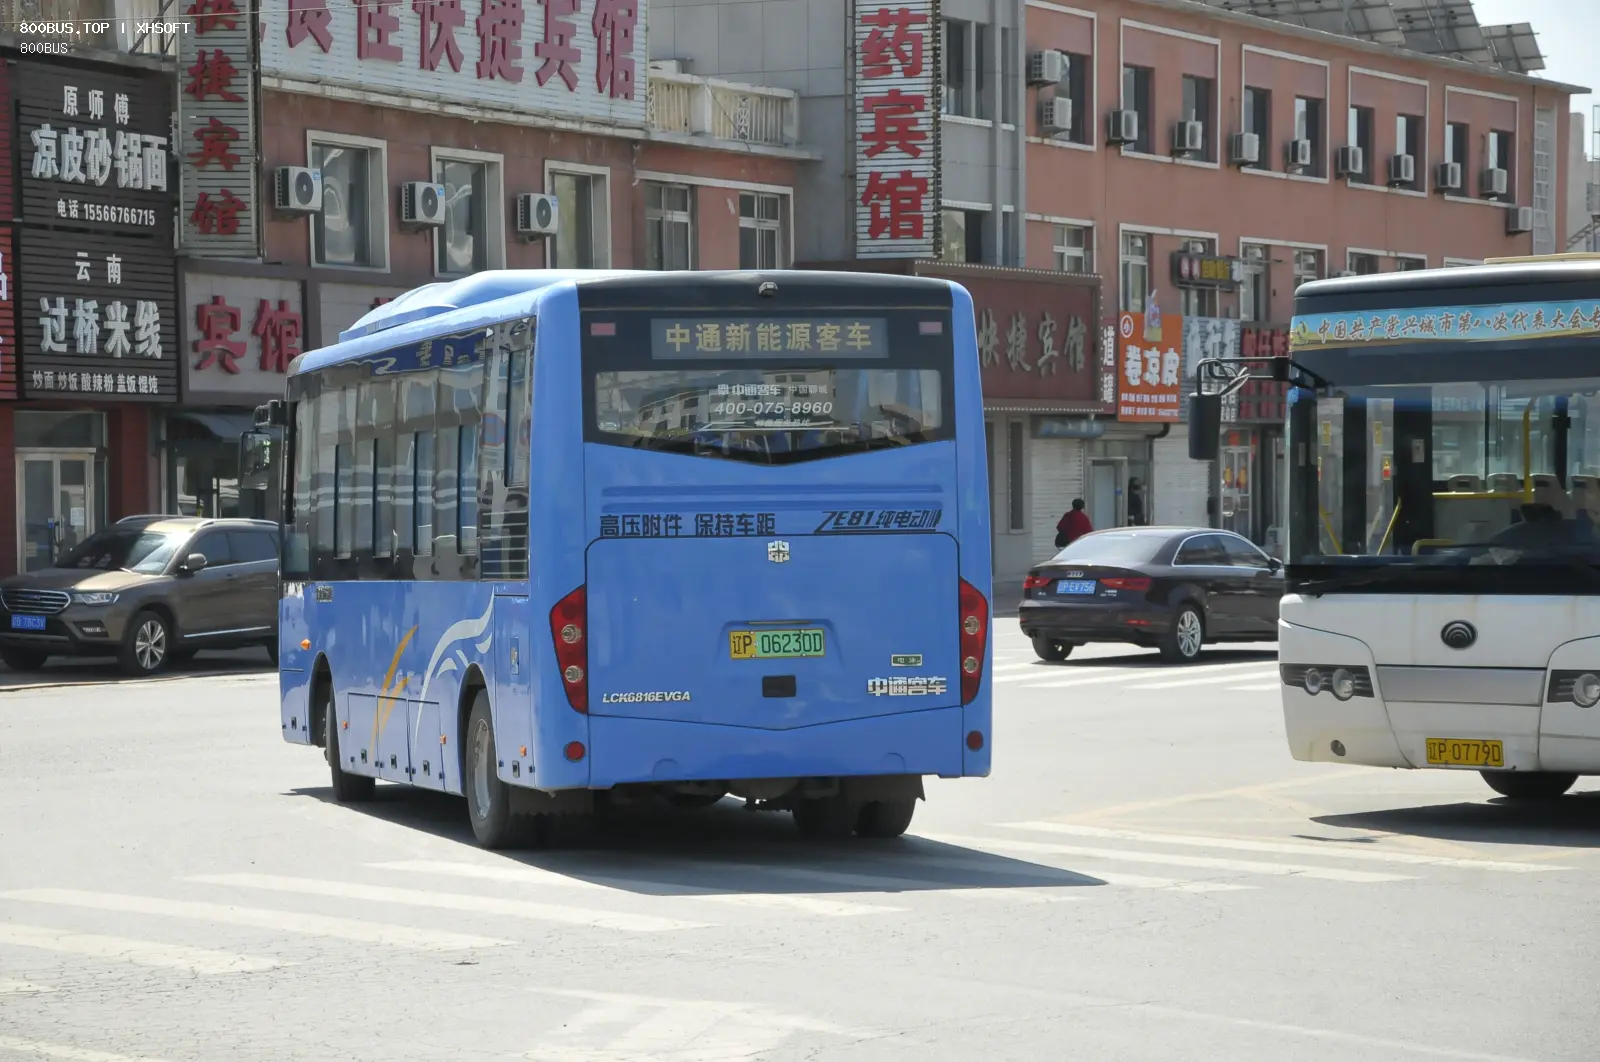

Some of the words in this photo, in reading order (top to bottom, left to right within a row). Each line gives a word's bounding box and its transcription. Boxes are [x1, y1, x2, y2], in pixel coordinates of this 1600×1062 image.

[63, 85, 130, 125] 原师傅
[861, 7, 929, 240] 药宾馆
[30, 123, 168, 192] 凉皮砂锅面
[57, 198, 79, 219] 电话
[83, 203, 156, 226] 15566766715
[75, 251, 122, 285] 云南
[39, 296, 162, 359] 过桥米线
[192, 295, 303, 374] 宾馆
[665, 322, 873, 352] 中通新能源客车
[978, 307, 1088, 378] 快捷宾馆
[714, 401, 834, 415] 400-075-8960
[600, 514, 682, 537] 高压附件
[694, 513, 776, 537] 保持车距
[602, 690, 691, 703] LCK6816EVGA
[868, 675, 947, 697] 中通客车
